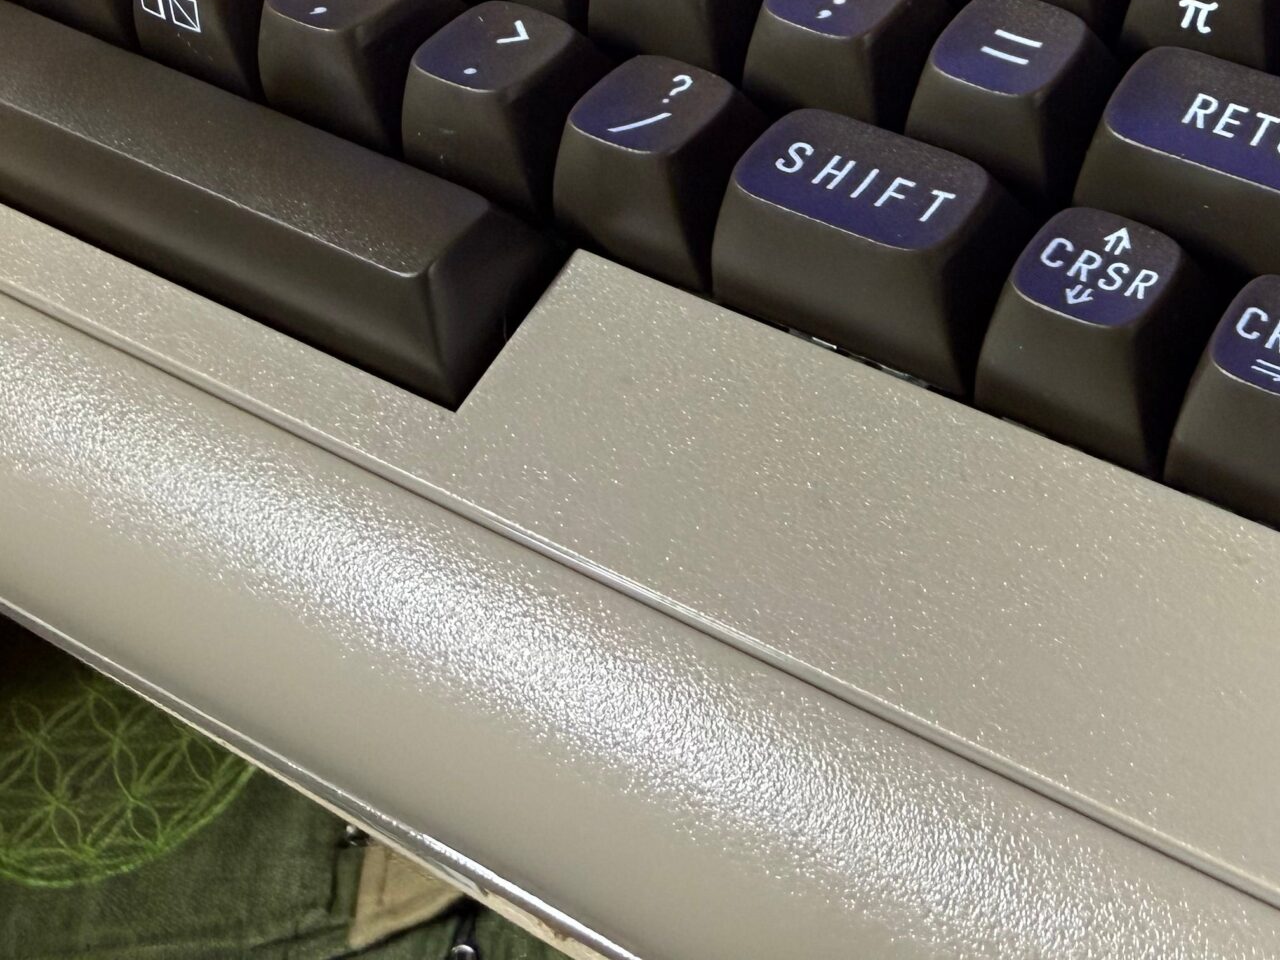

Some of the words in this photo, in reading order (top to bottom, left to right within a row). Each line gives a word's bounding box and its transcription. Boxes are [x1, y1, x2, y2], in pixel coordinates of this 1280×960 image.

[980, 28, 1043, 66] =
[662, 74, 693, 104] ?
[775, 141, 957, 226] SHIFT
[1039, 236, 1160, 301] CRSR
